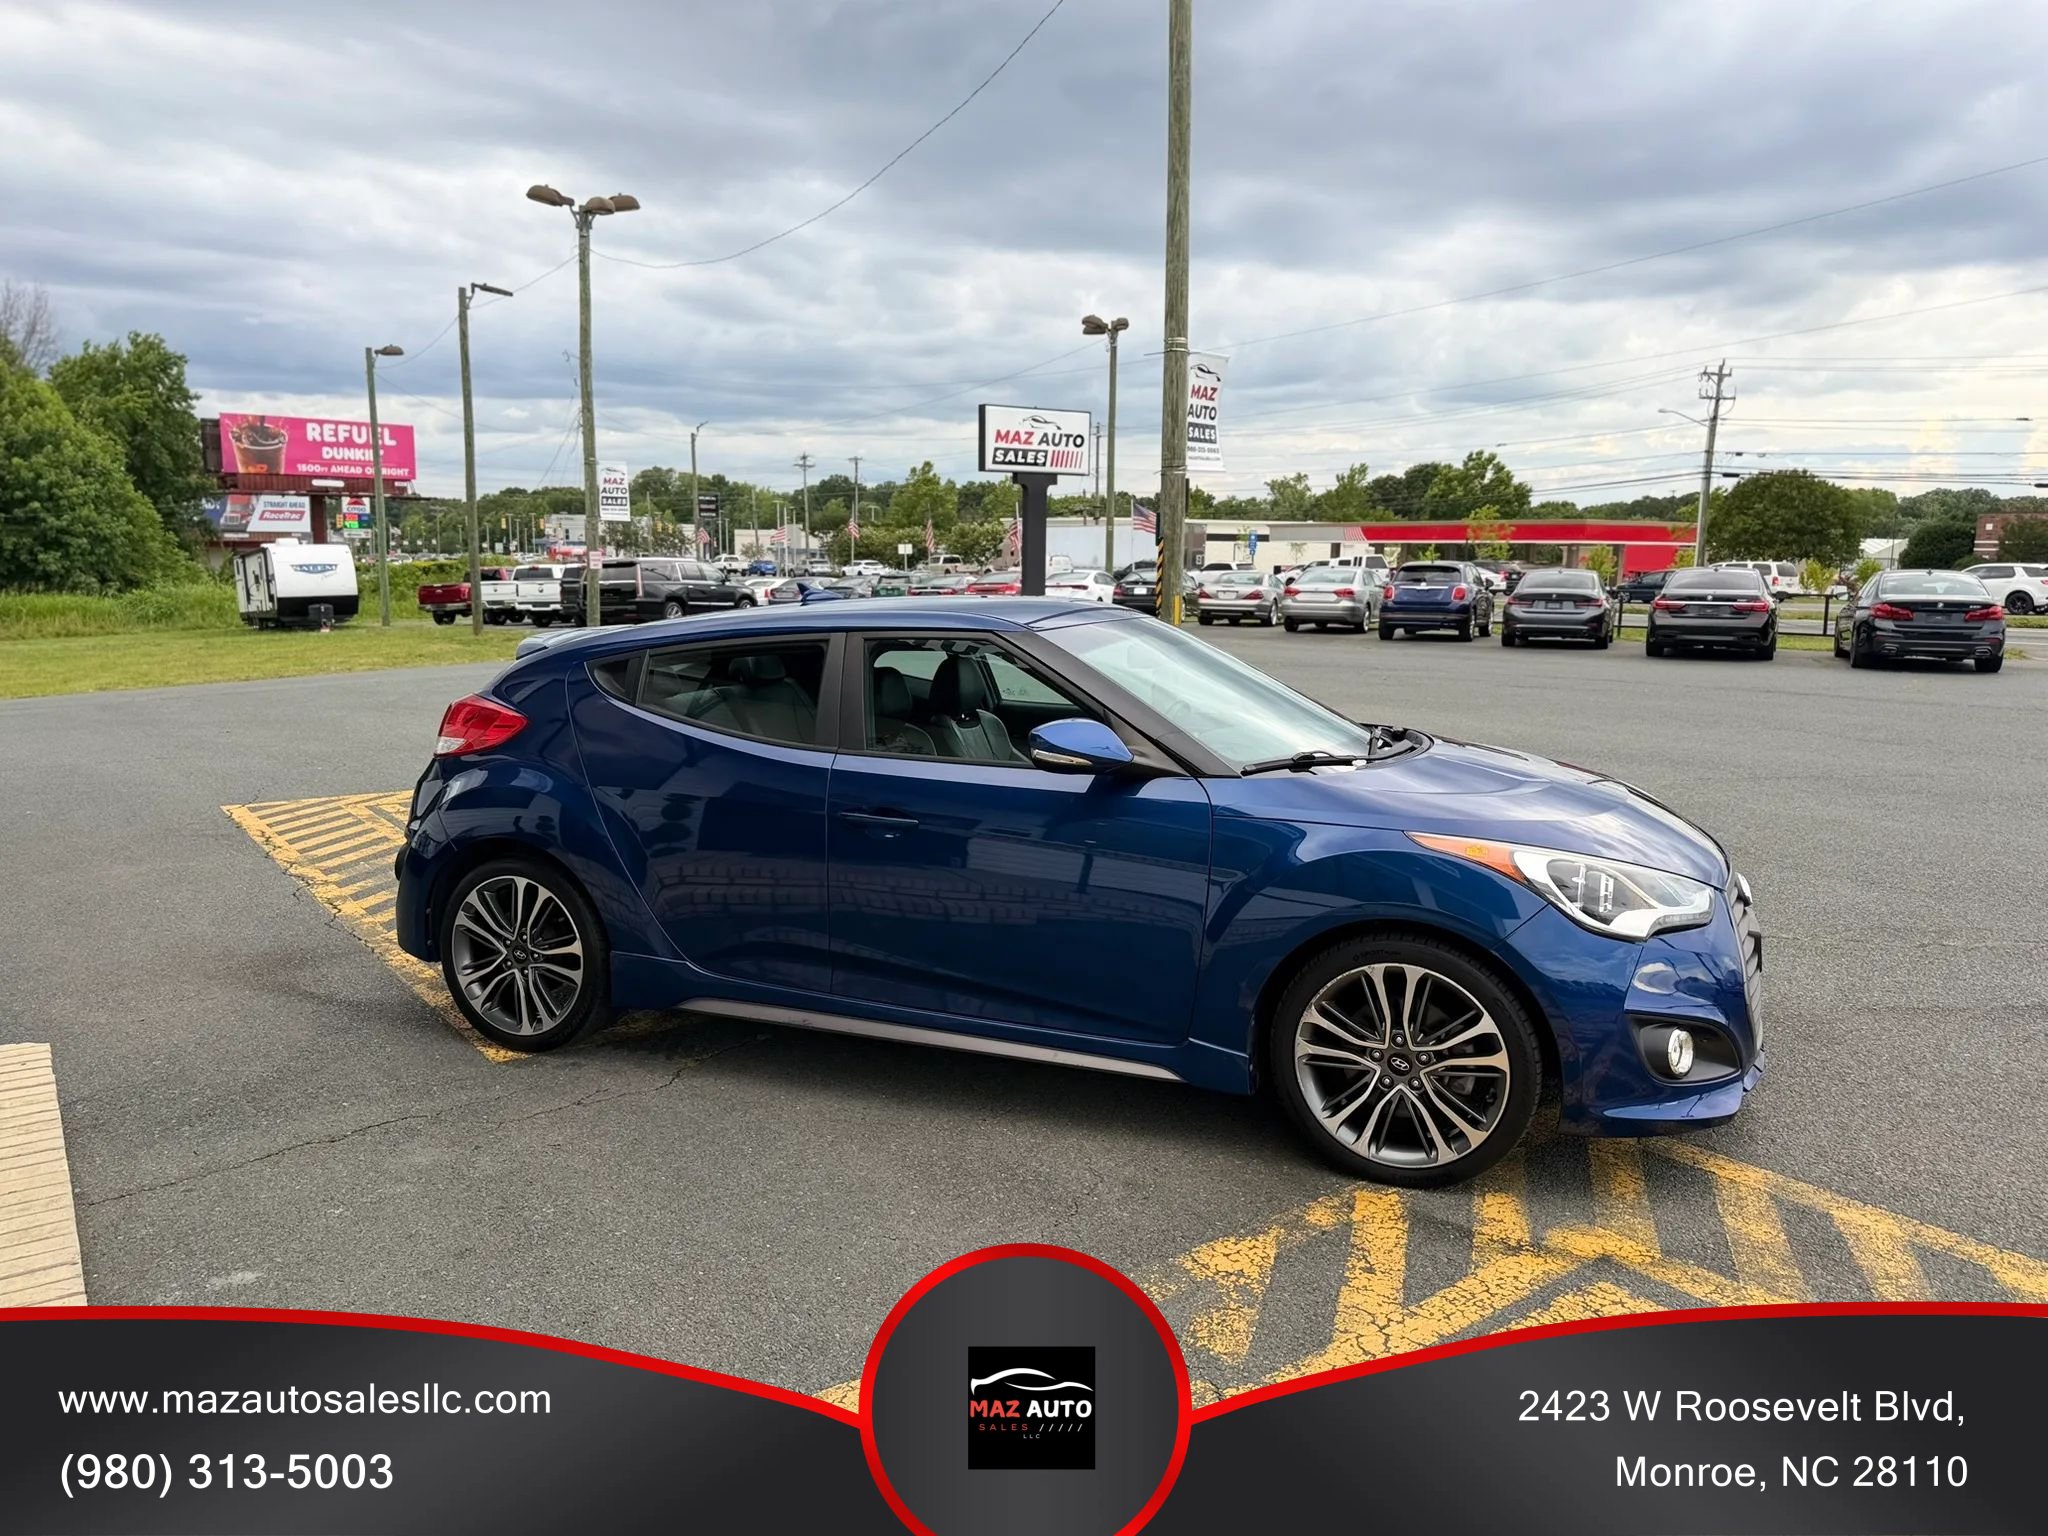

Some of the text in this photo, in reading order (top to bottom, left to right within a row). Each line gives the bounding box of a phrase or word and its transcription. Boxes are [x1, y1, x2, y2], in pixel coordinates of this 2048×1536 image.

[1191, 384, 1218, 401] MAZ
[1188, 403, 1217, 420] AUTO
[994, 429, 1085, 448] MAZ AUTO
[1188, 426, 1216, 440] SALES
[322, 446, 384, 462] DUNKI'
[994, 449, 1046, 464] SALES
[330, 464, 363, 474] AHEAD
[381, 467, 409, 477] RIGHT
[603, 477, 625, 485] MAZ
[263, 511, 303, 520] RaceTrac
